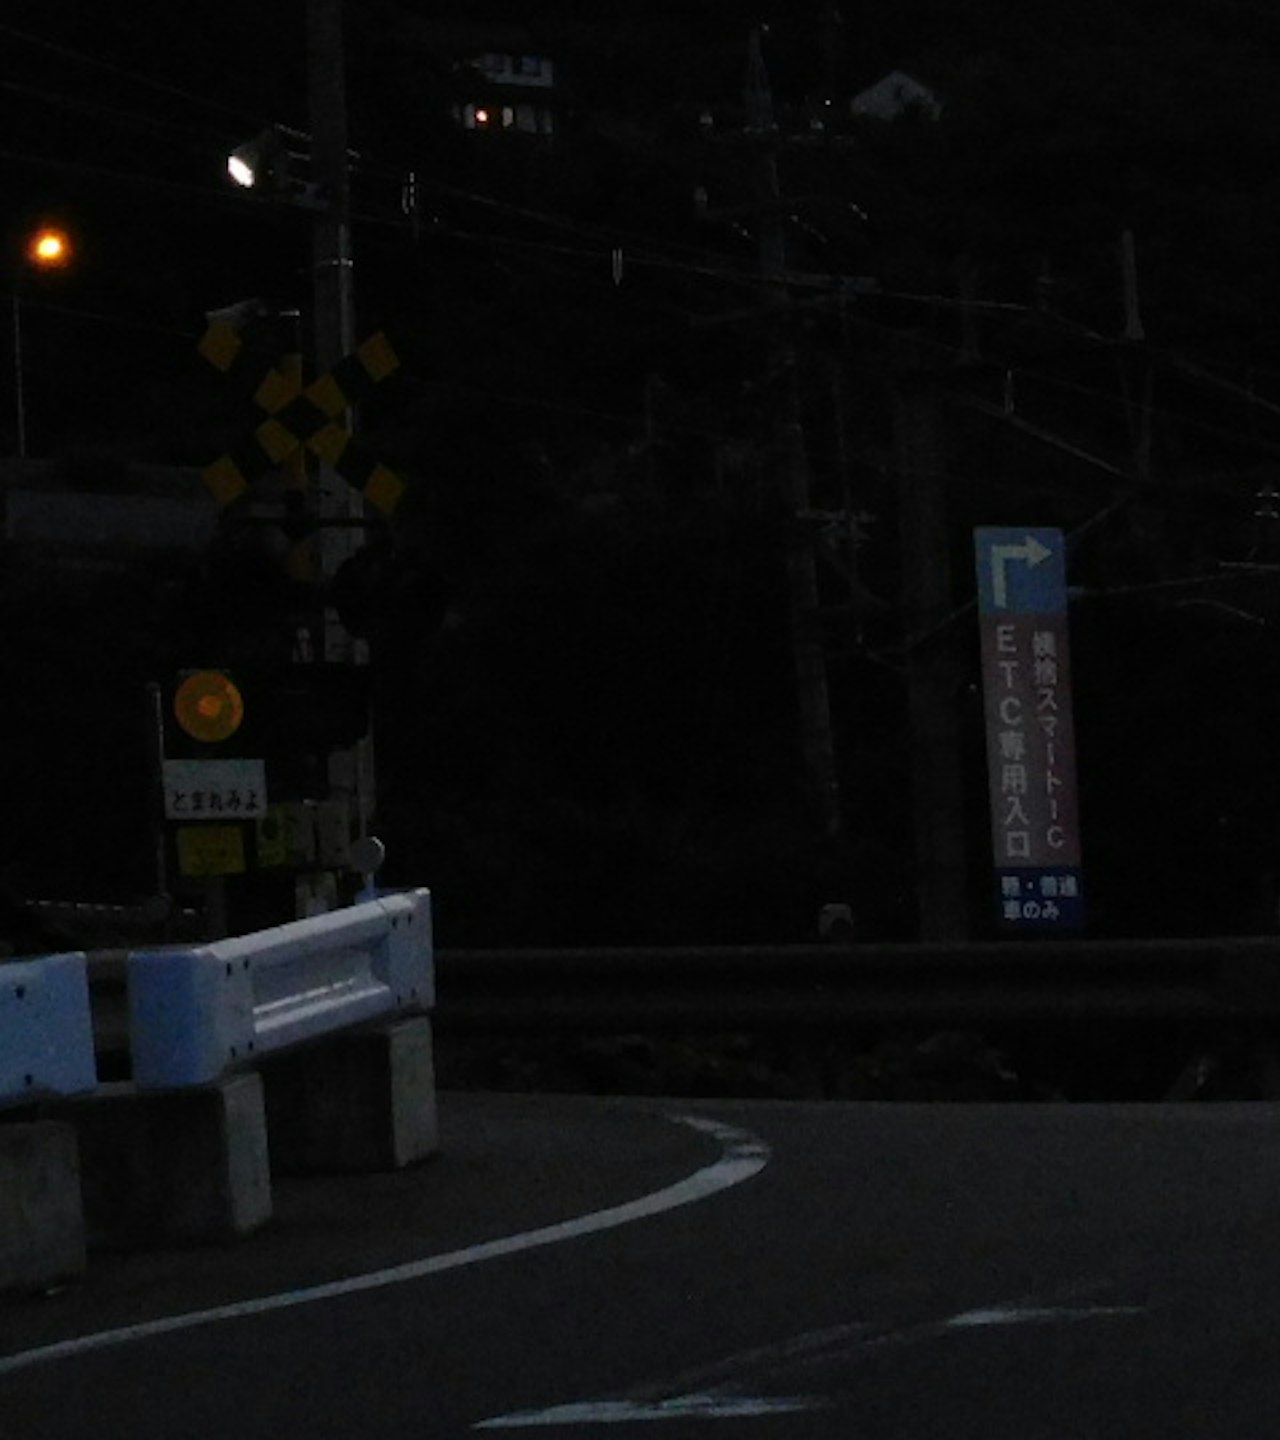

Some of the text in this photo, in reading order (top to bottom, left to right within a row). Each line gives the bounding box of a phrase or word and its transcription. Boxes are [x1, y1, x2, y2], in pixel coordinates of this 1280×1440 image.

[995, 626, 1031, 859] ETC専用入口
[172, 789, 258, 811] とまれみよ
[1002, 899, 1060, 921] 車のみ
